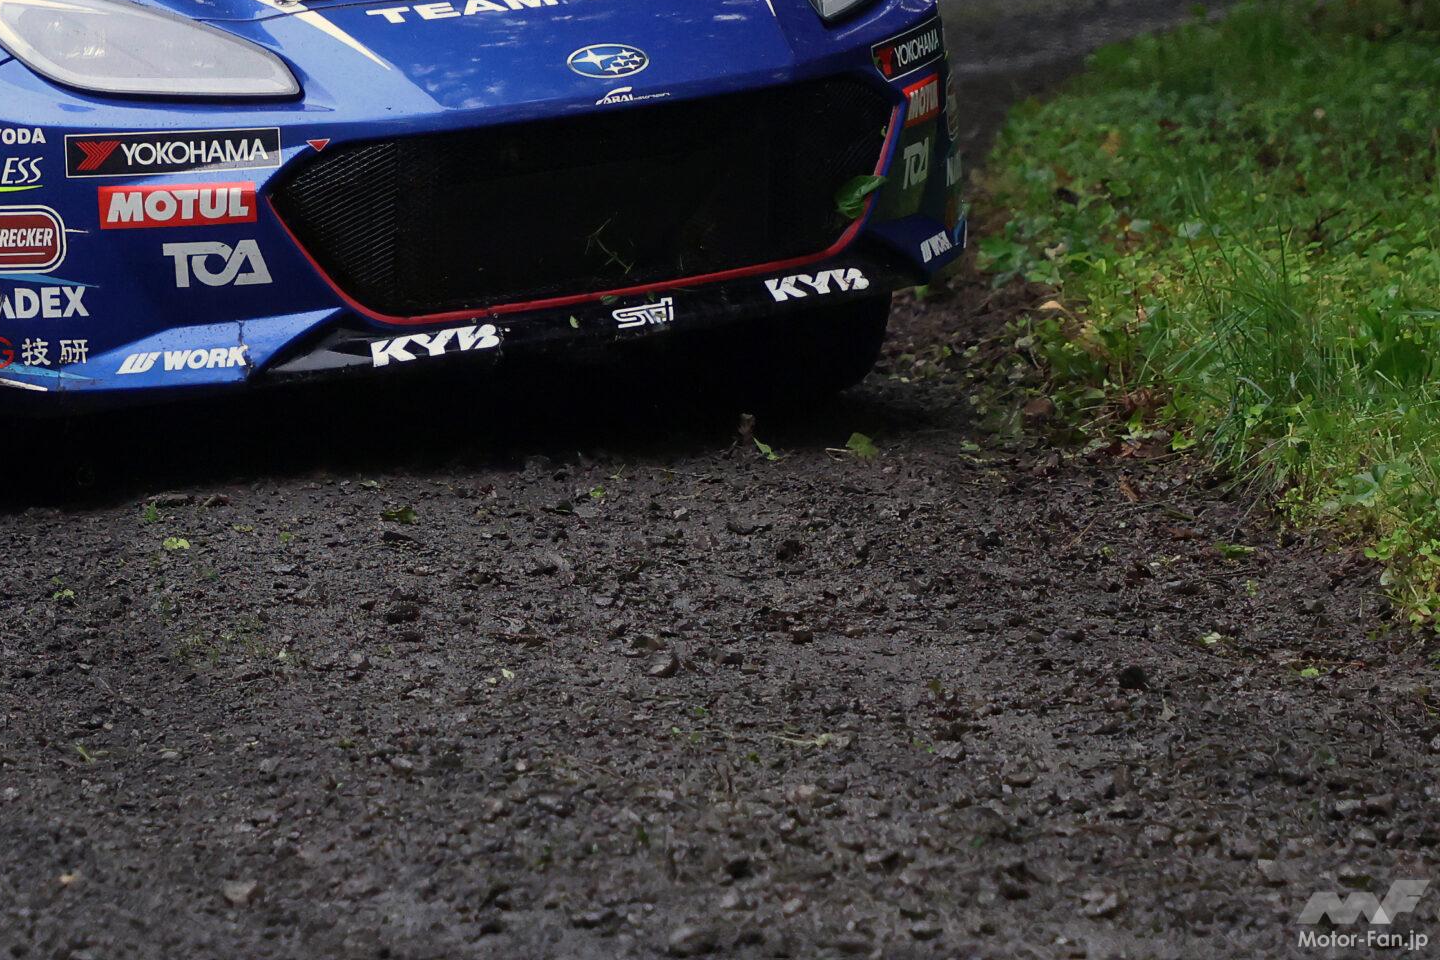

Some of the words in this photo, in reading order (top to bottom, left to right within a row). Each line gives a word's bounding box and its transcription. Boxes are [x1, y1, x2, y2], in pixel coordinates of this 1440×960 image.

[893, 28, 940, 68] YOKOHAMA
[120, 138, 268, 166] YOKOHAMA
[106, 187, 250, 224] MOTUL
[162, 239, 273, 289] TOA
[21, 337, 89, 366] 技研
[164, 345, 250, 371] WORK
